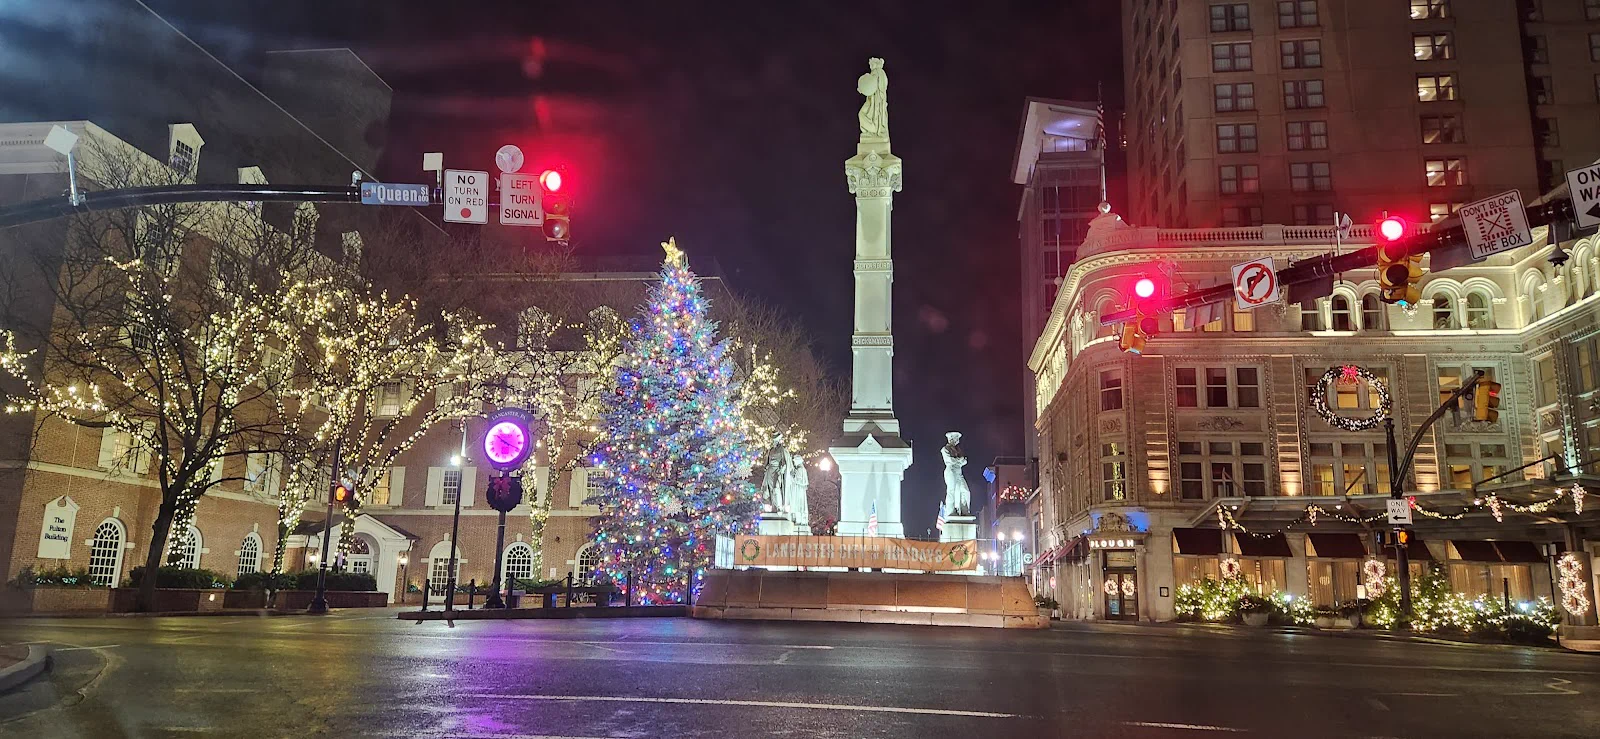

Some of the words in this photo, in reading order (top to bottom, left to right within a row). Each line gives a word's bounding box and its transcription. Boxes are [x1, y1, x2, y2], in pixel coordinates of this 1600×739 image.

[457, 174, 476, 185] NO
[1577, 168, 1600, 184] ON
[510, 179, 534, 190] LEFT
[377, 184, 418, 204] Queen
[454, 186, 479, 196] TURN
[448, 196, 462, 205] ON
[465, 197, 484, 207] RED
[510, 195, 535, 205] TURN
[1463, 203, 1487, 217] DON'T
[1488, 194, 1517, 210] BLOCK
[504, 208, 540, 220] SIGNAL
[1477, 241, 1498, 254] THE
[1501, 233, 1524, 248] BOX
[44, 533, 68, 542] Building
[766, 543, 835, 558] LANCASTER
[839, 544, 867, 559] CITY
[883, 544, 943, 564] HOLIDAYS
